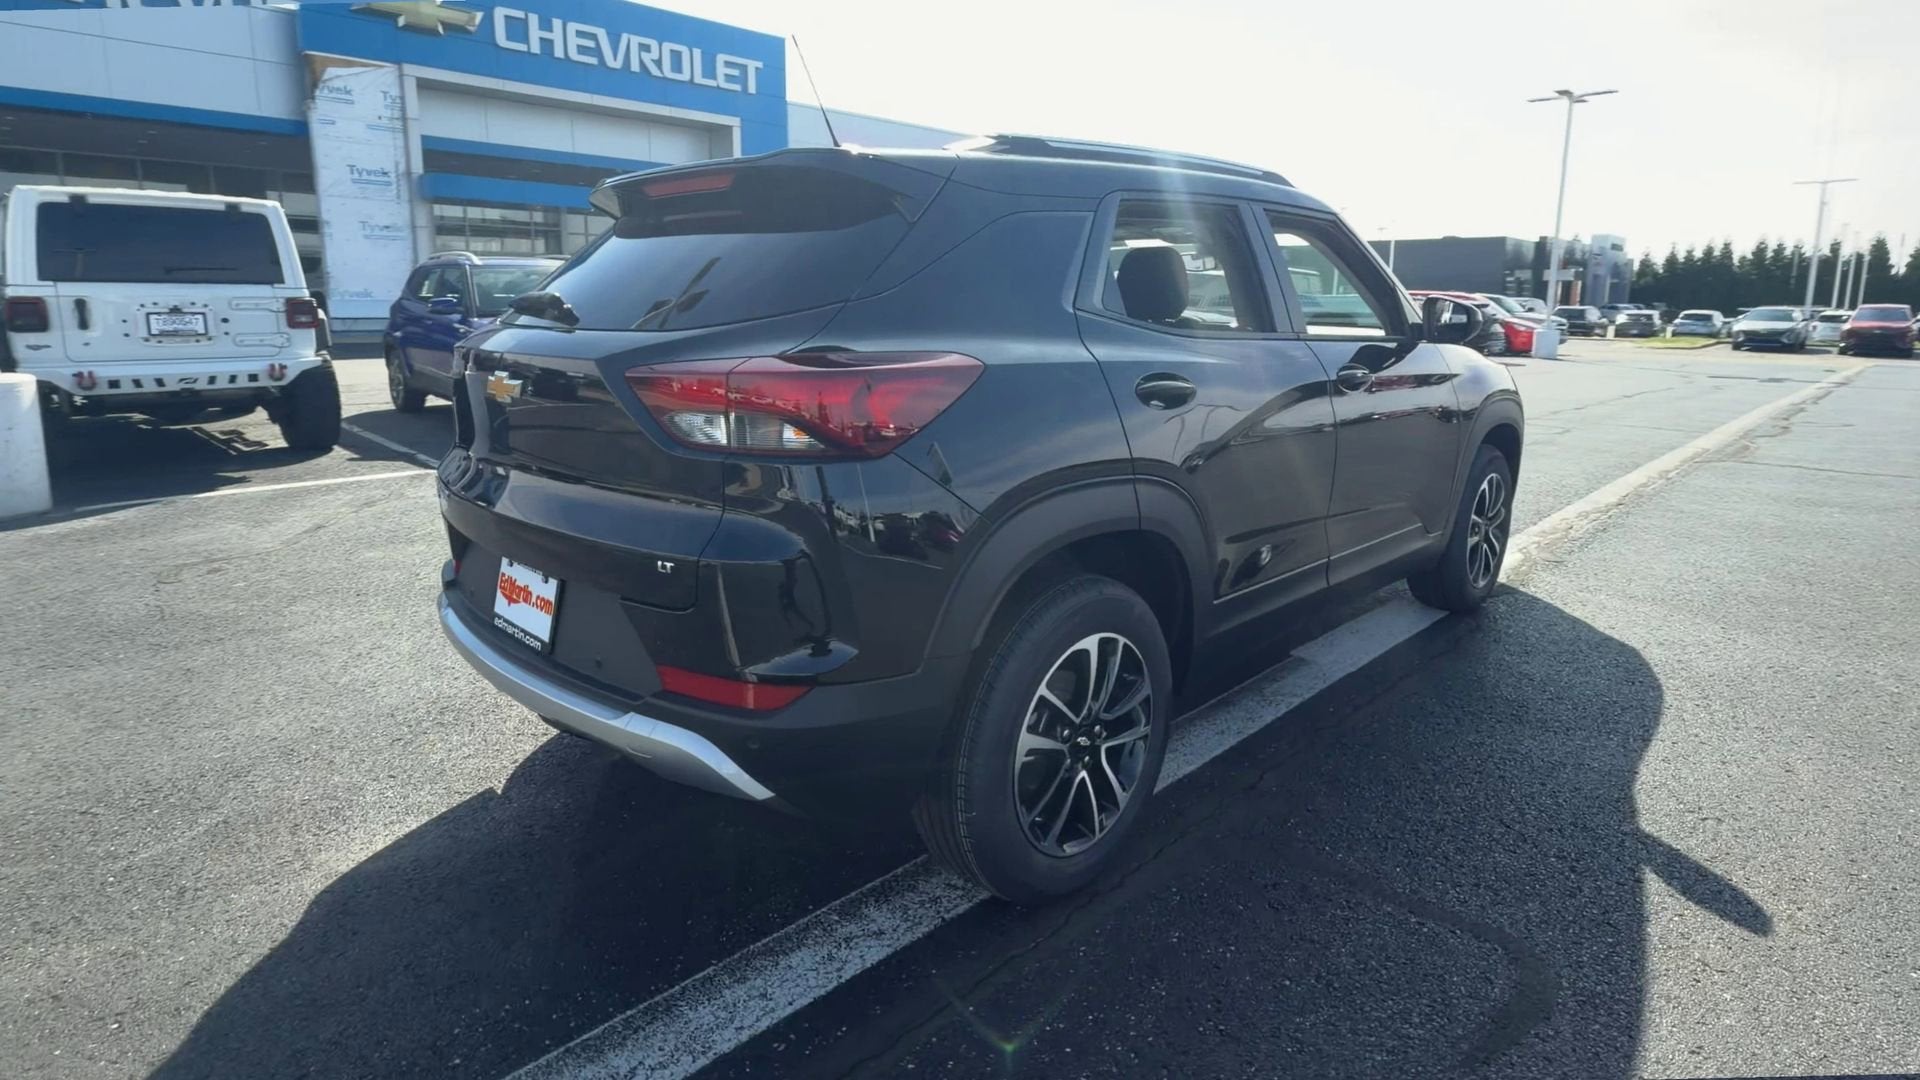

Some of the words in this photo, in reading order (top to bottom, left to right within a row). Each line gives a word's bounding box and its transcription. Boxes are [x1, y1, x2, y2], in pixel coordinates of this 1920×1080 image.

[494, 6, 763, 95] CHEVROLET
[346, 164, 391, 178] Tyvek
[657, 560, 674, 574] LT
[494, 617, 541, 651] edmartin.com
